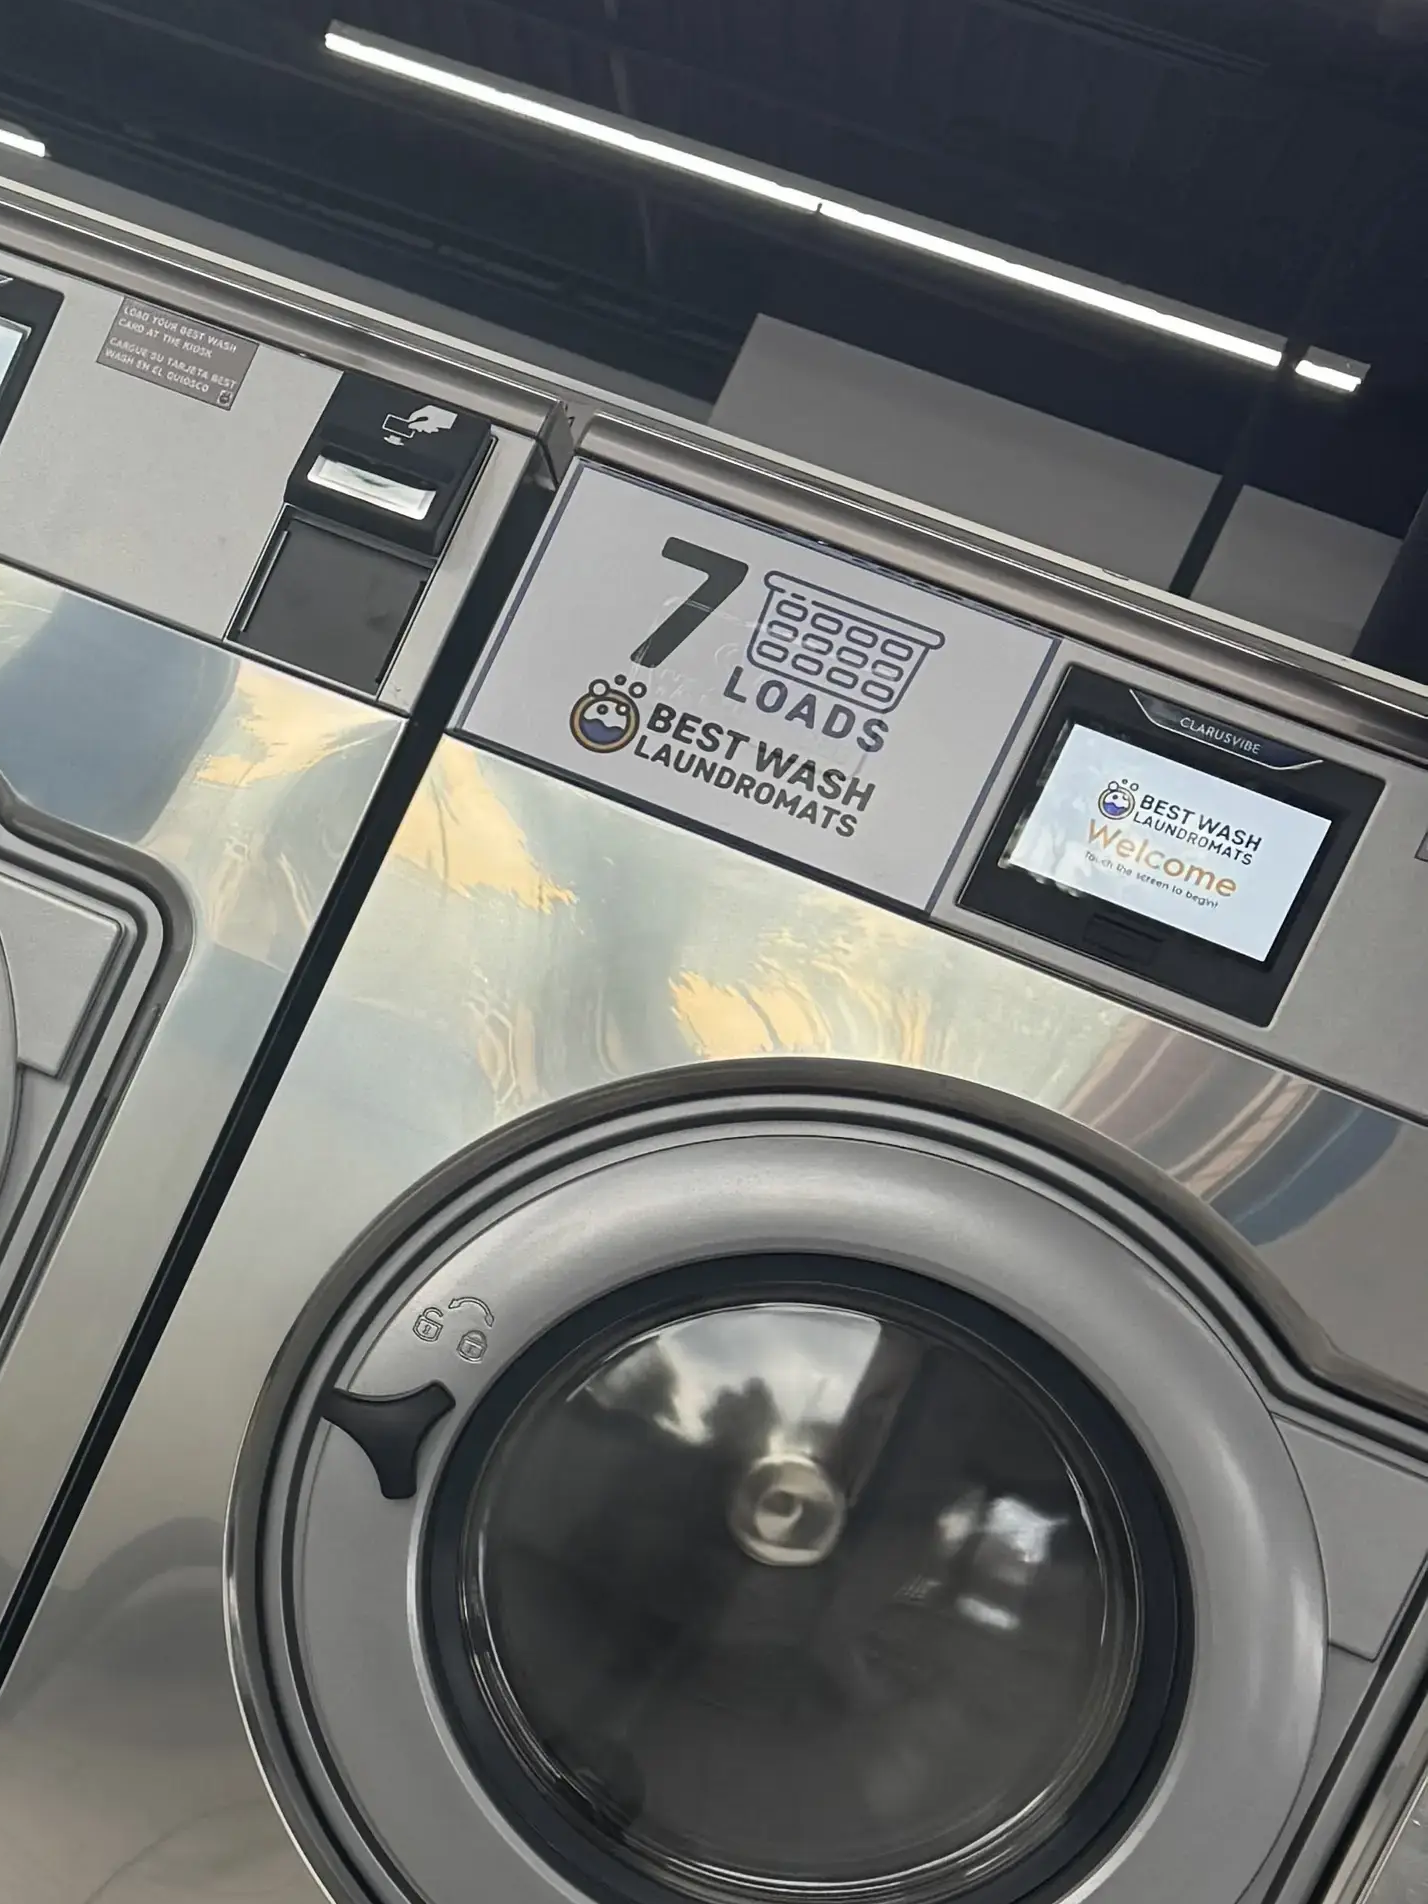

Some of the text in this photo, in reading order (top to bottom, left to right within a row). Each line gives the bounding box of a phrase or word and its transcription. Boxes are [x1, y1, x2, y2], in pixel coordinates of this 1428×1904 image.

[118, 318, 213, 359] CARD AT THE KIOSK
[124, 306, 237, 353] LOAD YOUR BEST WASH
[105, 347, 209, 393] WASH EN EL QUIOSCO
[109, 337, 237, 389] CARGUE SU TARJETA BEST
[630, 536, 749, 668] 7
[723, 665, 889, 753] LOADS
[1179, 717, 1261, 755] CLARUSVIBE
[647, 702, 876, 813] BEST WASH
[634, 735, 858, 838] LAUNDROMATS
[1133, 812, 1253, 866] LAUNDROMATS
[1140, 794, 1263, 852] BEST WASH
[1088, 819, 1236, 897] Welcome
[1116, 861, 1132, 876] the
[1136, 871, 1169, 891] screen
[1172, 882, 1184, 895] to
